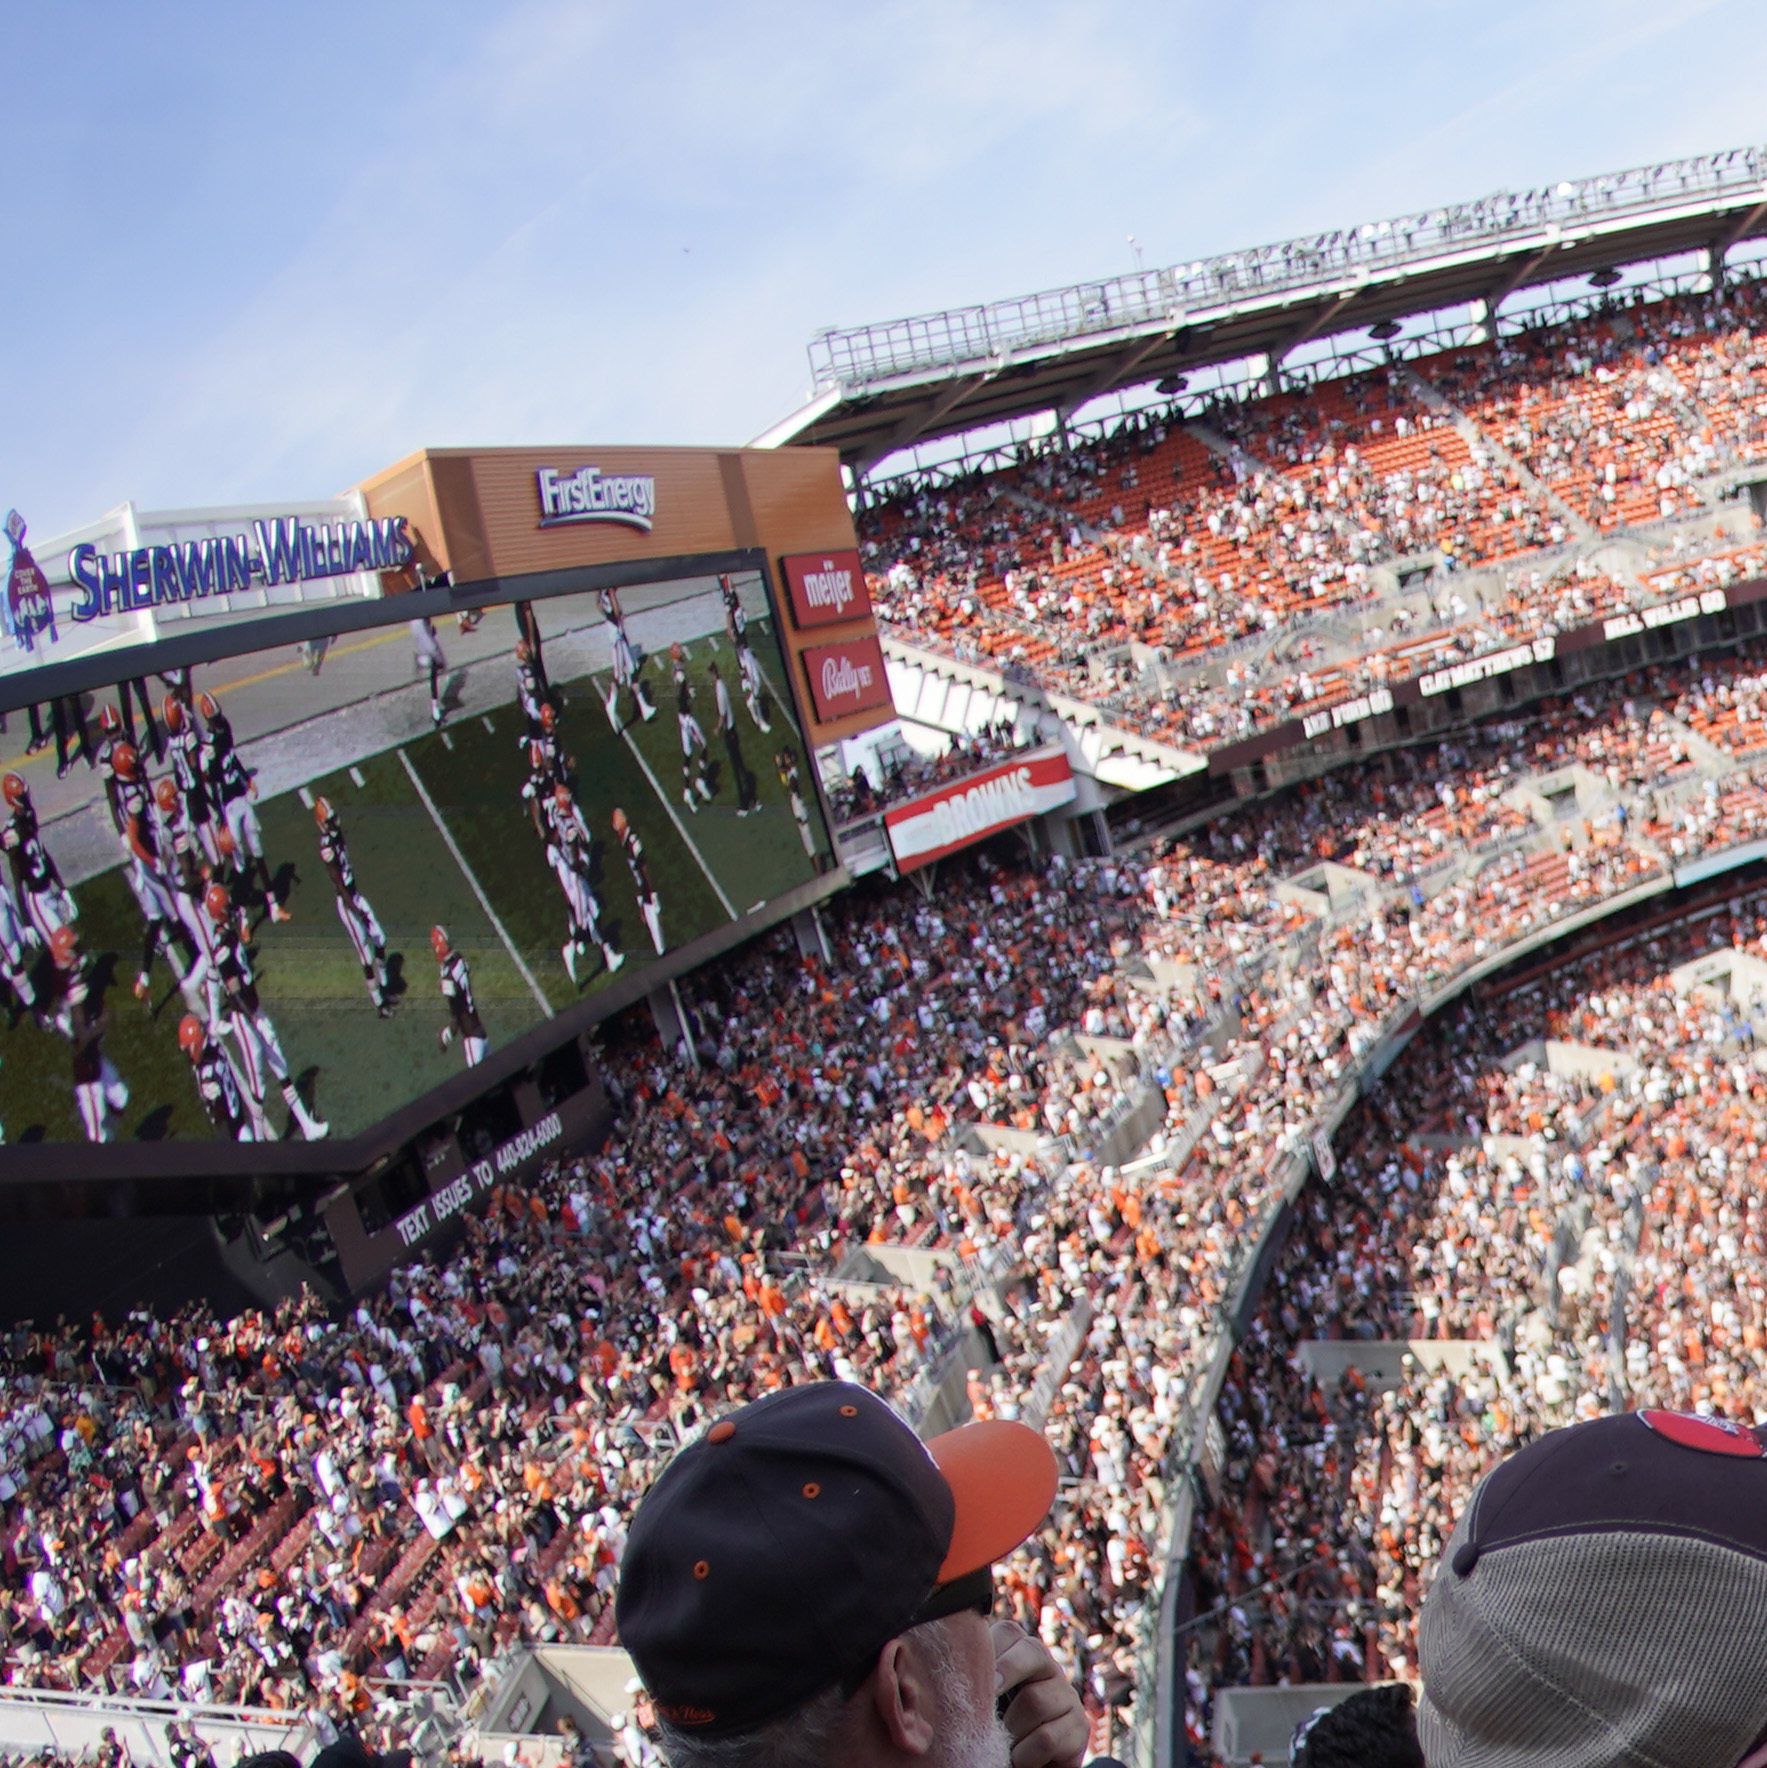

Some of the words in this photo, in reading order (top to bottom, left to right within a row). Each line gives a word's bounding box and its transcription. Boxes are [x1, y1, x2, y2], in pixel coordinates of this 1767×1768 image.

[539, 467, 655, 516] FirstEnergy
[69, 515, 413, 622] SHERWIN-WILLIAMS
[803, 560, 855, 614] meijer
[822, 655, 861, 700] Bally
[933, 766, 1038, 845] BROWNS
[395, 1203, 432, 1248] TEXT
[431, 1172, 474, 1223] ISSUES
[472, 1159, 494, 1191] TO
